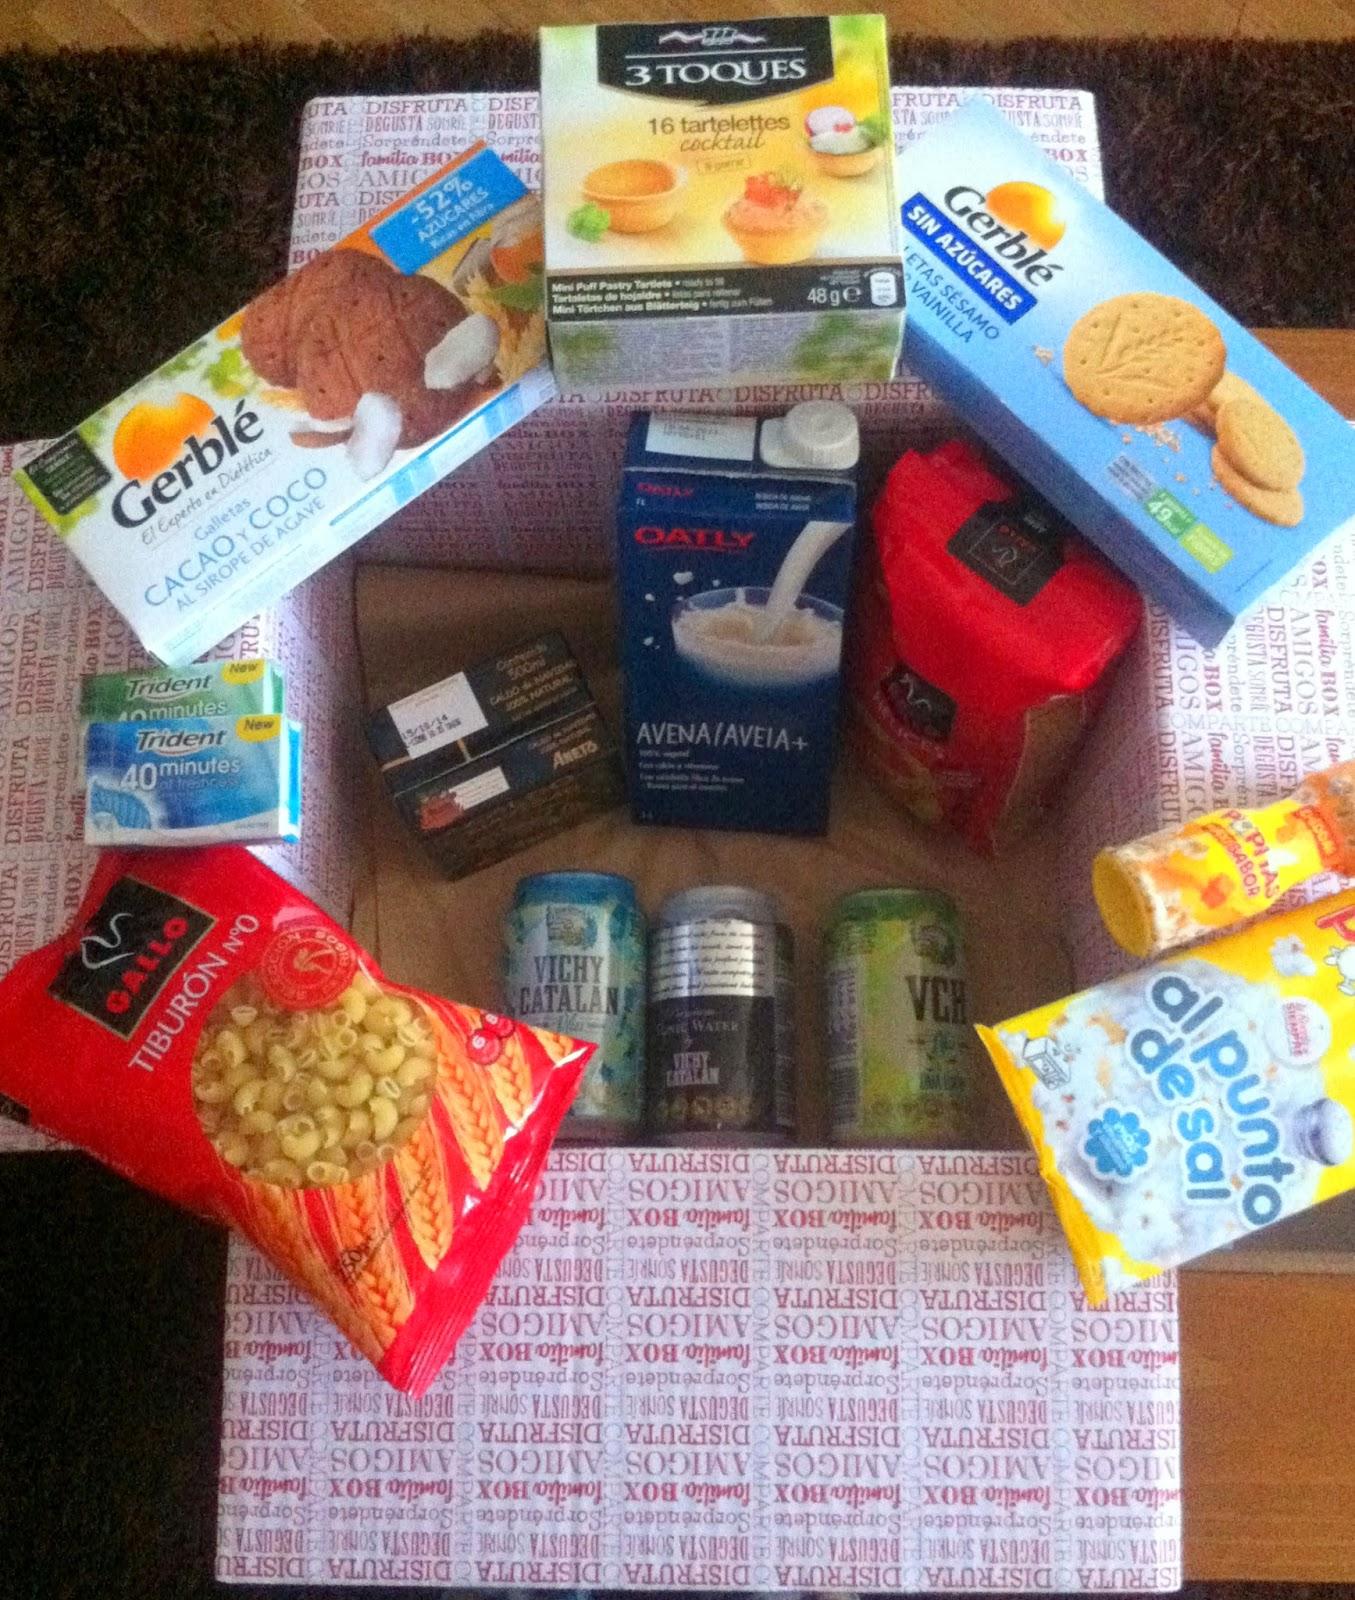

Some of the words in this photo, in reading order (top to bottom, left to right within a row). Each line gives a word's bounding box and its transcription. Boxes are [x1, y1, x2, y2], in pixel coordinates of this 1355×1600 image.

[624, 65, 651, 86] 3
[654, 57, 807, 86] TOQUES
[364, 97, 469, 116] DISFRUTA
[649, 116, 674, 135] 16
[680, 113, 791, 134] tartelettes
[679, 129, 766, 153] cocktail
[361, 149, 419, 168] familia
[411, 172, 473, 225] -52%
[943, 184, 1065, 288] Gerblé
[907, 204, 937, 239] SIN
[935, 225, 1023, 312] AZÚCARES
[551, 282, 574, 294] Mini
[806, 286, 828, 305] 48
[552, 303, 574, 315] Mini
[912, 279, 974, 345] VAINILLA
[734, 384, 846, 403] DISFRUTA
[111, 398, 265, 529] Gerblé
[157, 494, 202, 533] Experto
[193, 497, 251, 542] Galletas
[143, 533, 235, 608] CACAO
[248, 466, 327, 531] COCO
[634, 526, 756, 549] OATLY
[175, 591, 195, 612] AL
[194, 551, 251, 595] SIROPE
[250, 536, 274, 557] DE
[275, 496, 326, 541] AGAVE
[228, 661, 258, 674] New
[1266, 606, 1293, 715] DISFRUTA
[1290, 607, 1318, 716] AMIGOS
[126, 673, 213, 698] Trident
[1204, 664, 1223, 712] BOX
[1320, 670, 1339, 717] BOX
[149, 699, 228, 720] minutes
[242, 717, 275, 732] New
[136, 728, 228, 753] Trident
[119, 762, 158, 791] 40
[158, 756, 241, 778] minutes
[105, 916, 190, 1015] GALLO
[533, 954, 605, 984] VICHY
[518, 984, 620, 1016] CATALAN
[1150, 974, 1224, 1035] al
[127, 951, 229, 1075] TIBURÓN
[1129, 1027, 1197, 1102] de
[1189, 1028, 1296, 1227] punto
[629, 1152, 751, 1175] DISFRUTA
[773, 1153, 897, 1175] DISFRUTA
[1176, 1106, 1232, 1201] sal
[628, 1178, 752, 1202] AMIGOS
[772, 1179, 898, 1204] AMIGOS
[537, 1207, 607, 1232] familia
[626, 1208, 680, 1227] BOX
[684, 1207, 751, 1233] familia
[772, 1209, 826, 1228] BOX
[830, 1209, 897, 1234] familia
[918, 1210, 972, 1230] BOX
[976, 1209, 1044, 1235] familia
[626, 1286, 751, 1308] DISFRUTA
[773, 1287, 899, 1310] DISFRUTA
[919, 1289, 1047, 1311] DISFRUTA
[481, 1312, 605, 1337] AMIGOS
[626, 1313, 752, 1338] AMIGOS
[773, 1314, 902, 1340] AMIGOS
[920, 1316, 1047, 1342] AMIGOS
[478, 1342, 532, 1362] BOX
[536, 1342, 604, 1367] familia
[625, 1343, 679, 1363] BOX
[684, 1343, 751, 1369] familia
[772, 1344, 827, 1365] BOX
[829, 1343, 899, 1370] familia
[919, 1346, 974, 1368] BOX
[980, 1346, 1048, 1373] familia
[1071, 1348, 1126, 1369] BOX
[331, 1420, 456, 1442] DISFRUTA
[478, 1421, 604, 1444] DISFRUTA
[624, 1423, 753, 1446] DISFRUTA
[772, 1424, 901, 1448] DISFRUTA
[922, 1426, 1051, 1449] DISFRUTA
[330, 1447, 454, 1473] AMIGOS
[477, 1449, 604, 1475] AMIGOS
[625, 1451, 752, 1476] AMIGOS
[774, 1452, 901, 1479] AMIGOS
[923, 1454, 1051, 1480] AMIGOS
[328, 1477, 381, 1498] BOX
[385, 1476, 453, 1503] familia
[477, 1479, 529, 1500] BOX
[532, 1479, 604, 1505] familia
[624, 1480, 678, 1502] BOX
[684, 1480, 751, 1507] familia
[774, 1483, 828, 1504] BOX
[830, 1483, 901, 1510] familia
[923, 1485, 977, 1505] BOX
[983, 1486, 1051, 1512] familia
[1073, 1486, 1130, 1508] BOX
[327, 1557, 451, 1581] DISFRUTA
[474, 1560, 603, 1584] DISFRUTA
[622, 1562, 751, 1586] DISFRUTA
[774, 1564, 903, 1589] DISFRUTA
[924, 1566, 1052, 1590] DISFRUTA
